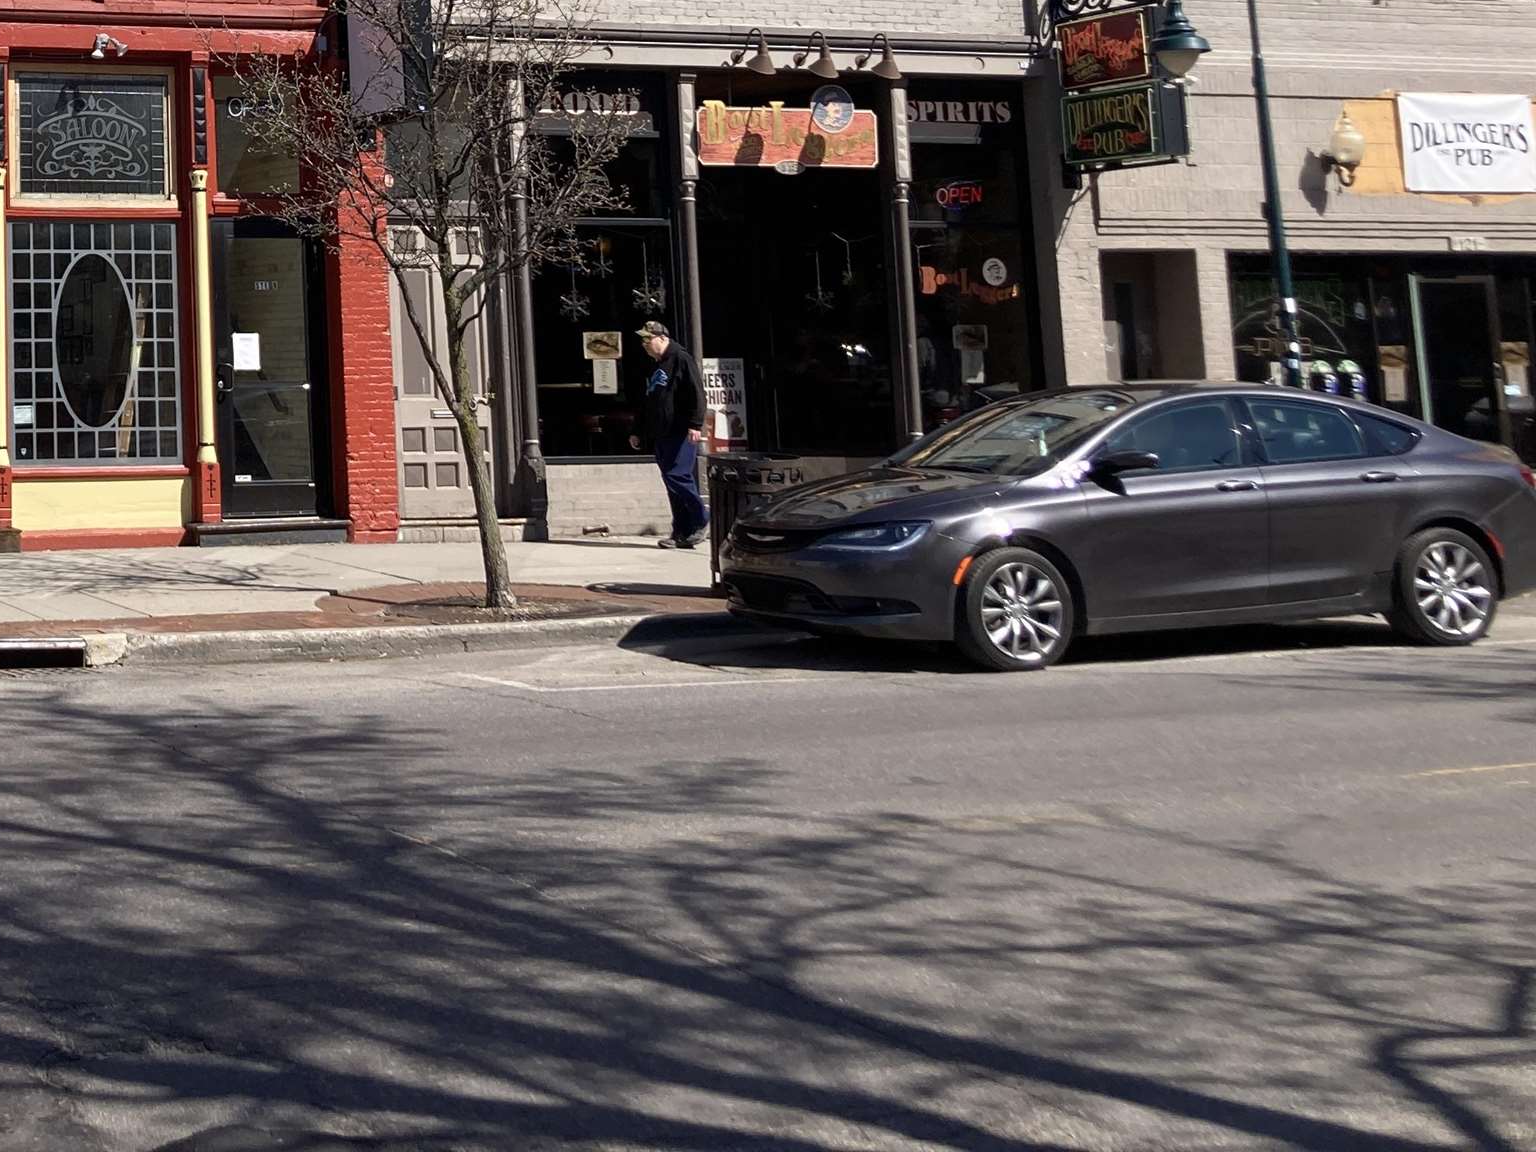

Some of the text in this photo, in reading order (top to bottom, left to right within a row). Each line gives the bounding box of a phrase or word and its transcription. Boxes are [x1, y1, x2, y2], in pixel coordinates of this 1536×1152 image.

[906, 100, 1012, 124] SPIRITS
[1067, 92, 1148, 145] DILLINGER'S
[48, 116, 140, 147] SALOON
[1093, 128, 1127, 155] PUB
[1409, 121, 1529, 154] DILLINGER'S
[1454, 148, 1493, 166] PUB
[935, 186, 983, 206] OPEN
[703, 373, 736, 388] HEERS
